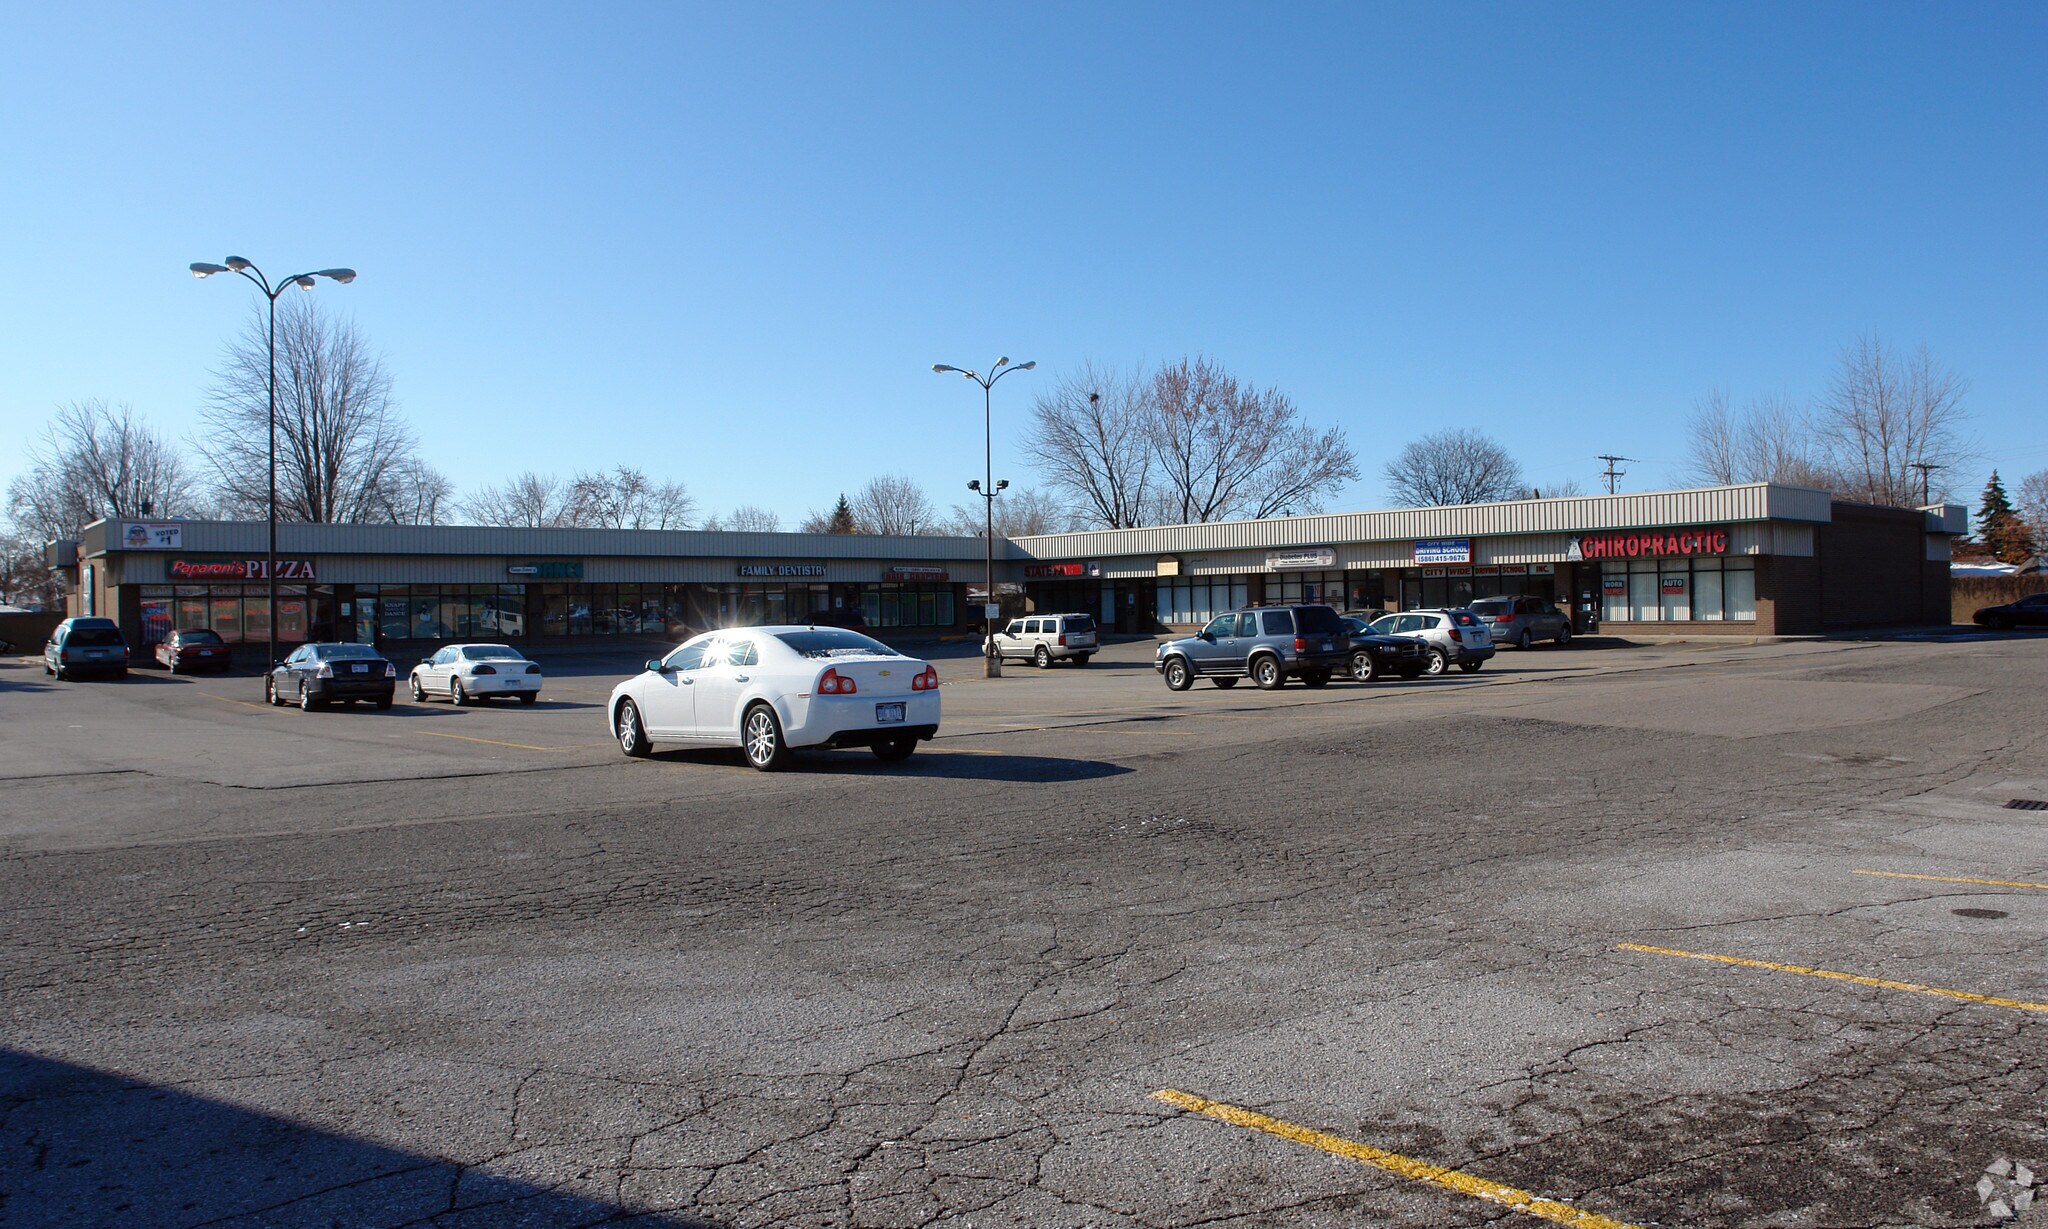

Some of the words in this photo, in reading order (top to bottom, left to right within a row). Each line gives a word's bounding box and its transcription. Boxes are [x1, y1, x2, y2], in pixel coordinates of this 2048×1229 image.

[1415, 547, 1442, 555] DRIVING
[1442, 545, 1468, 554] SCHOOL
[1582, 530, 1726, 558] CHIROPRACTIC
[173, 560, 245, 577] Paparoni's
[245, 560, 316, 579] PIZZA
[741, 565, 775, 577] FAMILY
[778, 565, 827, 577] DENTISTRY
[1024, 565, 1052, 578] STATE
[1424, 569, 1444, 577] CITY
[1448, 567, 1471, 576] WIDE
[1474, 566, 1499, 575] DRIVING
[1502, 565, 1526, 574] SCHOOL
[1663, 579, 1683, 587] AUTO
